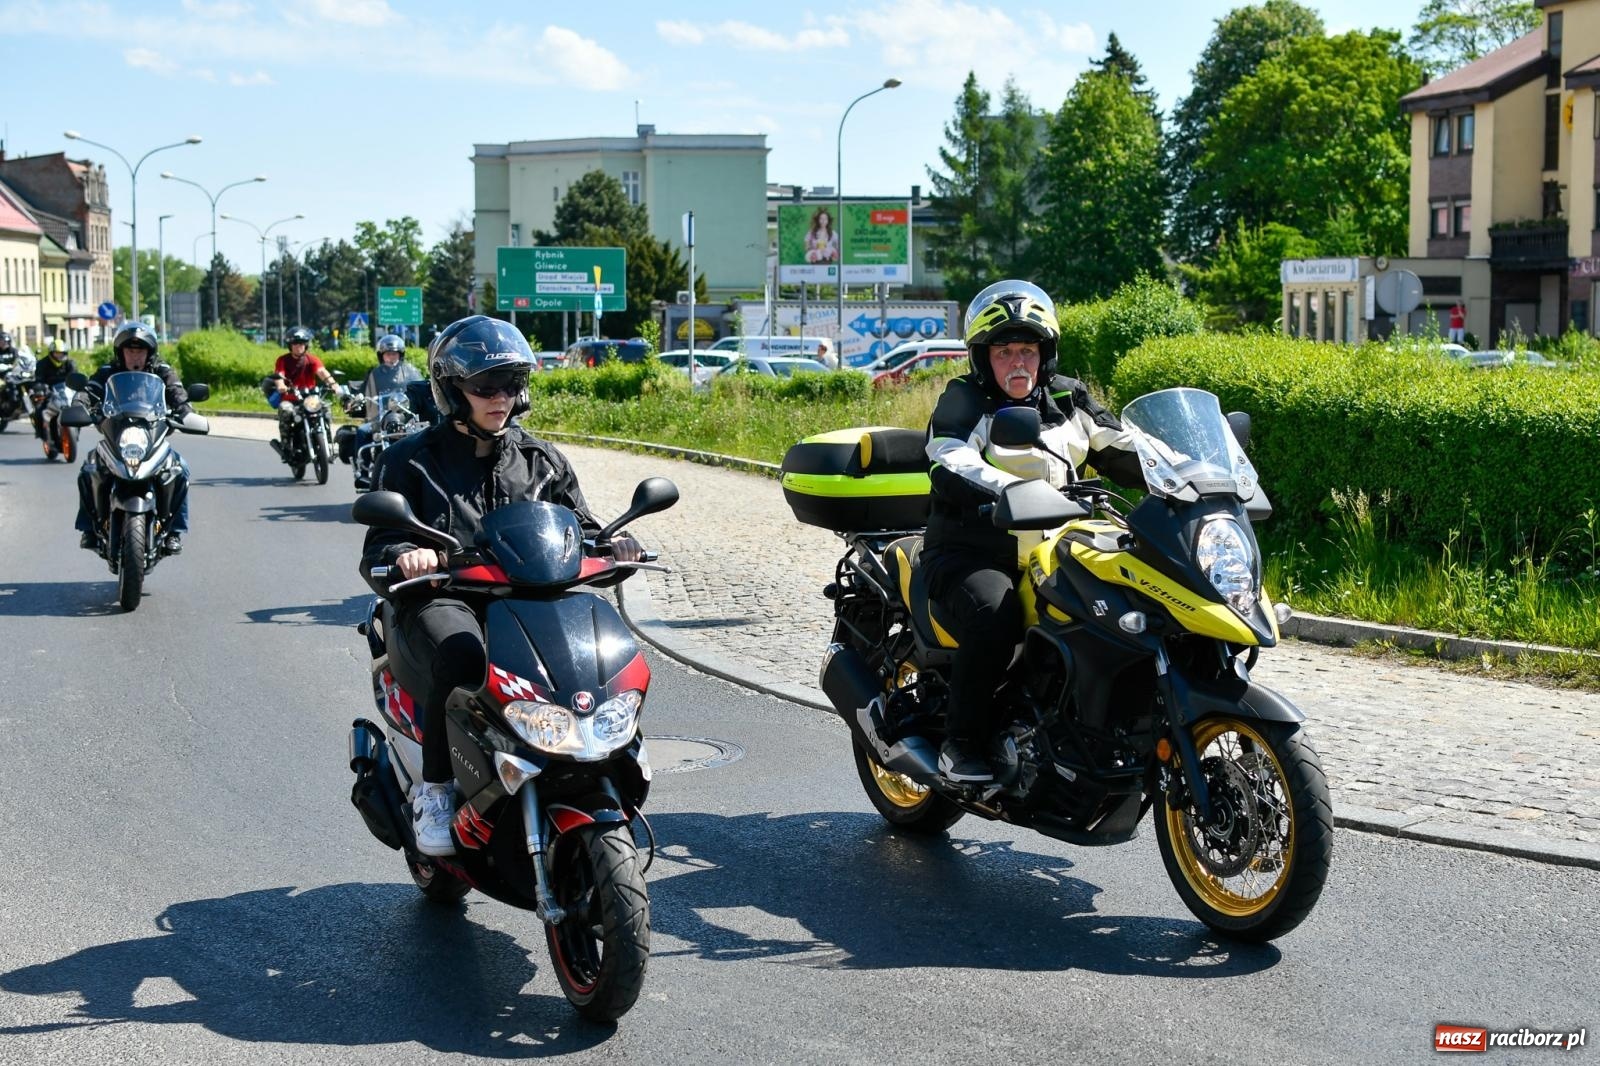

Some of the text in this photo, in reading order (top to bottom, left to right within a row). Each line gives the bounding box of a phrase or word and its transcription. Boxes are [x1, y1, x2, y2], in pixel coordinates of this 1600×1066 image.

[535, 250, 564, 260] Rybnik
[534, 261, 567, 270] Gliwice
[535, 298, 562, 307] Opole
[452, 746, 480, 779] GILERA
